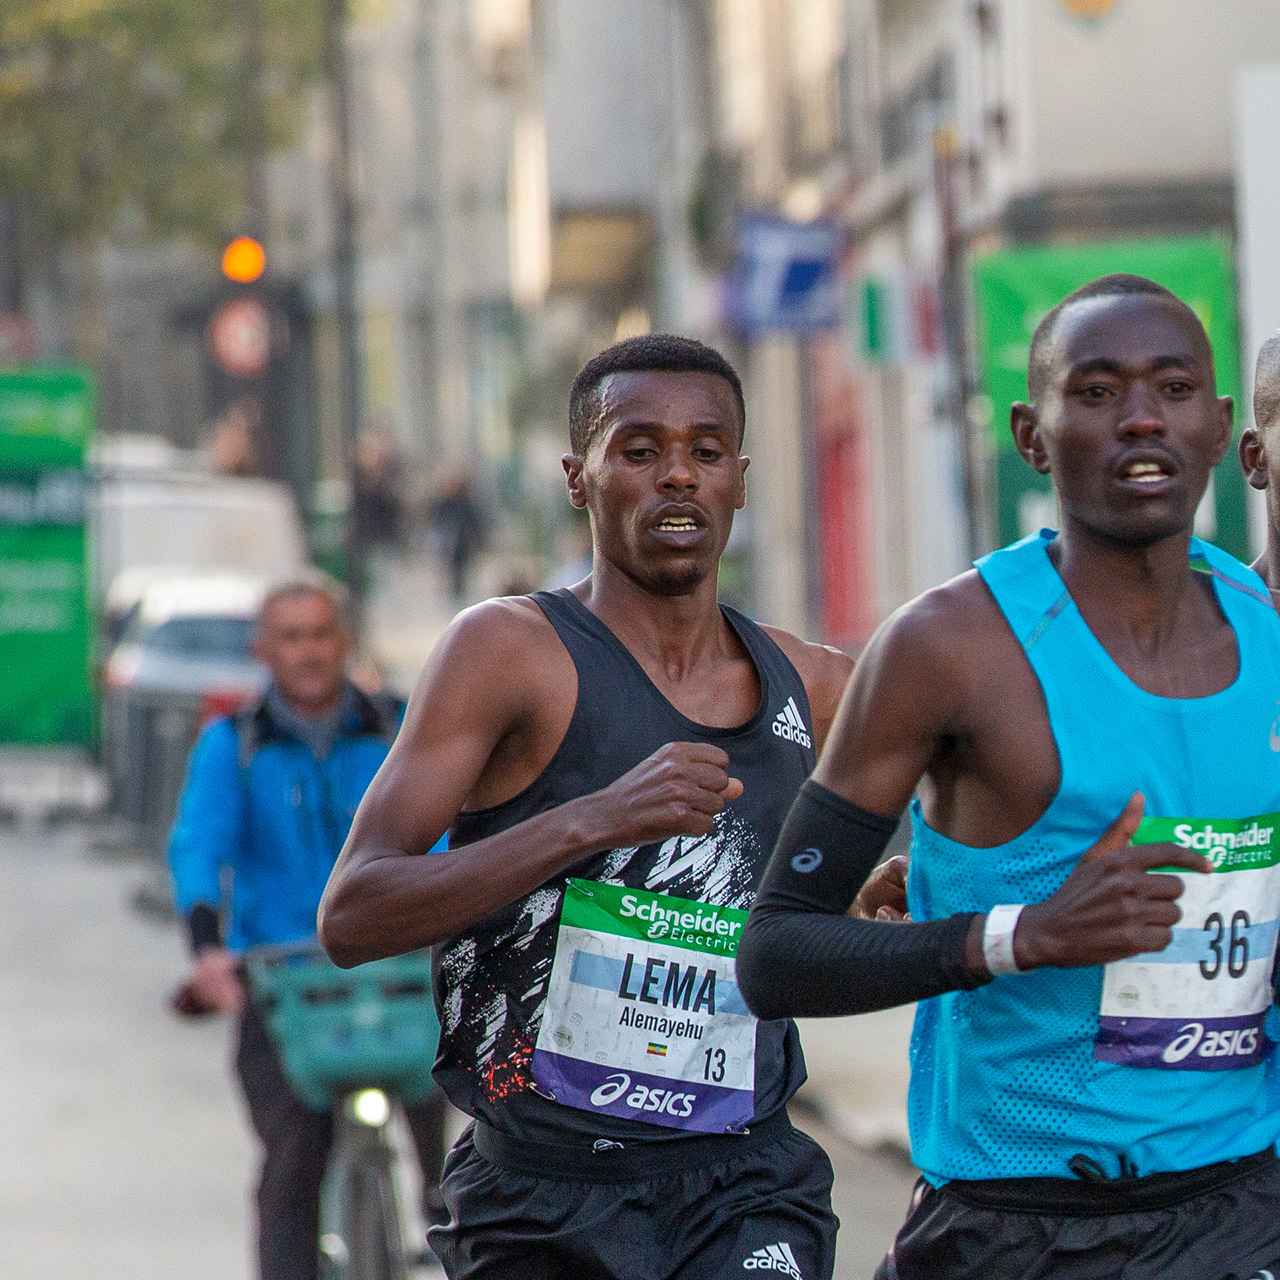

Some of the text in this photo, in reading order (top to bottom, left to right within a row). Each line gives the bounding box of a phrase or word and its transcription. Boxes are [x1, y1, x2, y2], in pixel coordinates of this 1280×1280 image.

[772, 721, 811, 749] adidas
[1174, 822, 1274, 849] Schneider
[619, 894, 742, 937] Schneider
[669, 928, 736, 953] Electric
[1199, 909, 1251, 981] 36
[617, 953, 718, 1017] LEMA
[618, 1005, 704, 1041] Alemayehu
[703, 1047, 727, 1083] 13
